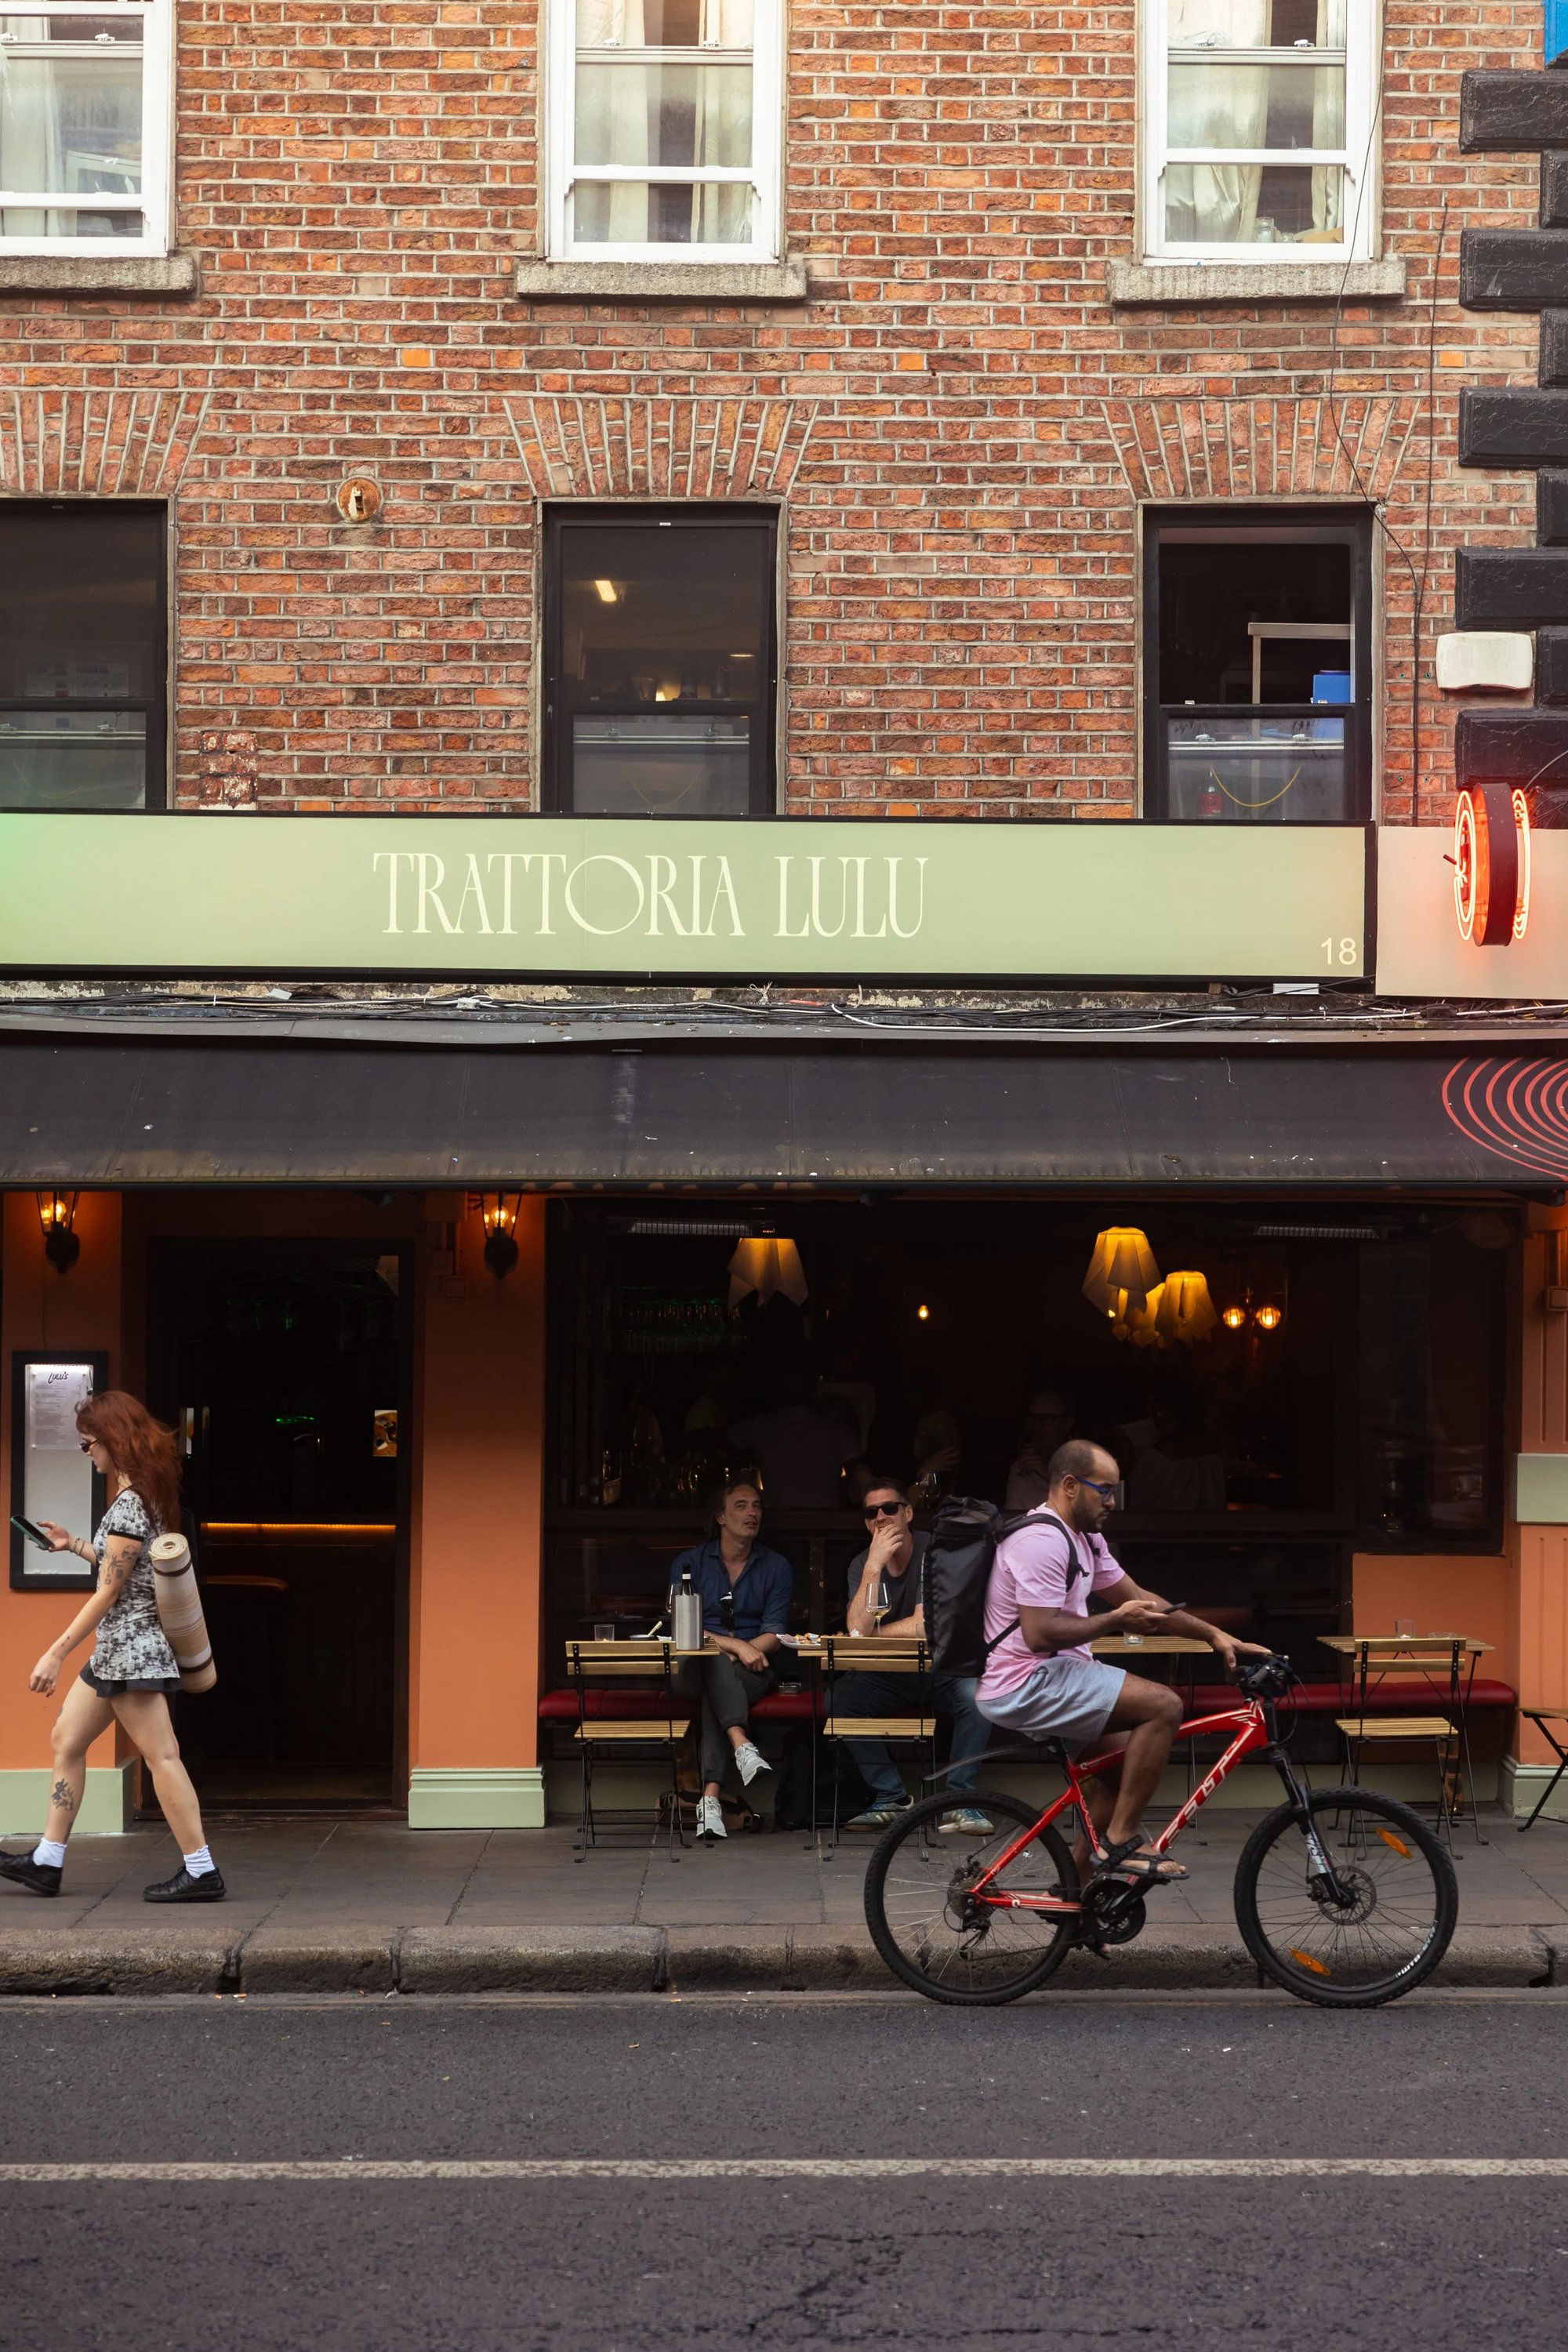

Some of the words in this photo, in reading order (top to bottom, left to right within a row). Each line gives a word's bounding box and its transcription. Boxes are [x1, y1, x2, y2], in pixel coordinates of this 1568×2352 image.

[373, 852, 746, 936] TRATTORIA
[772, 856, 929, 938] LULU
[1321, 937, 1357, 965] 18
